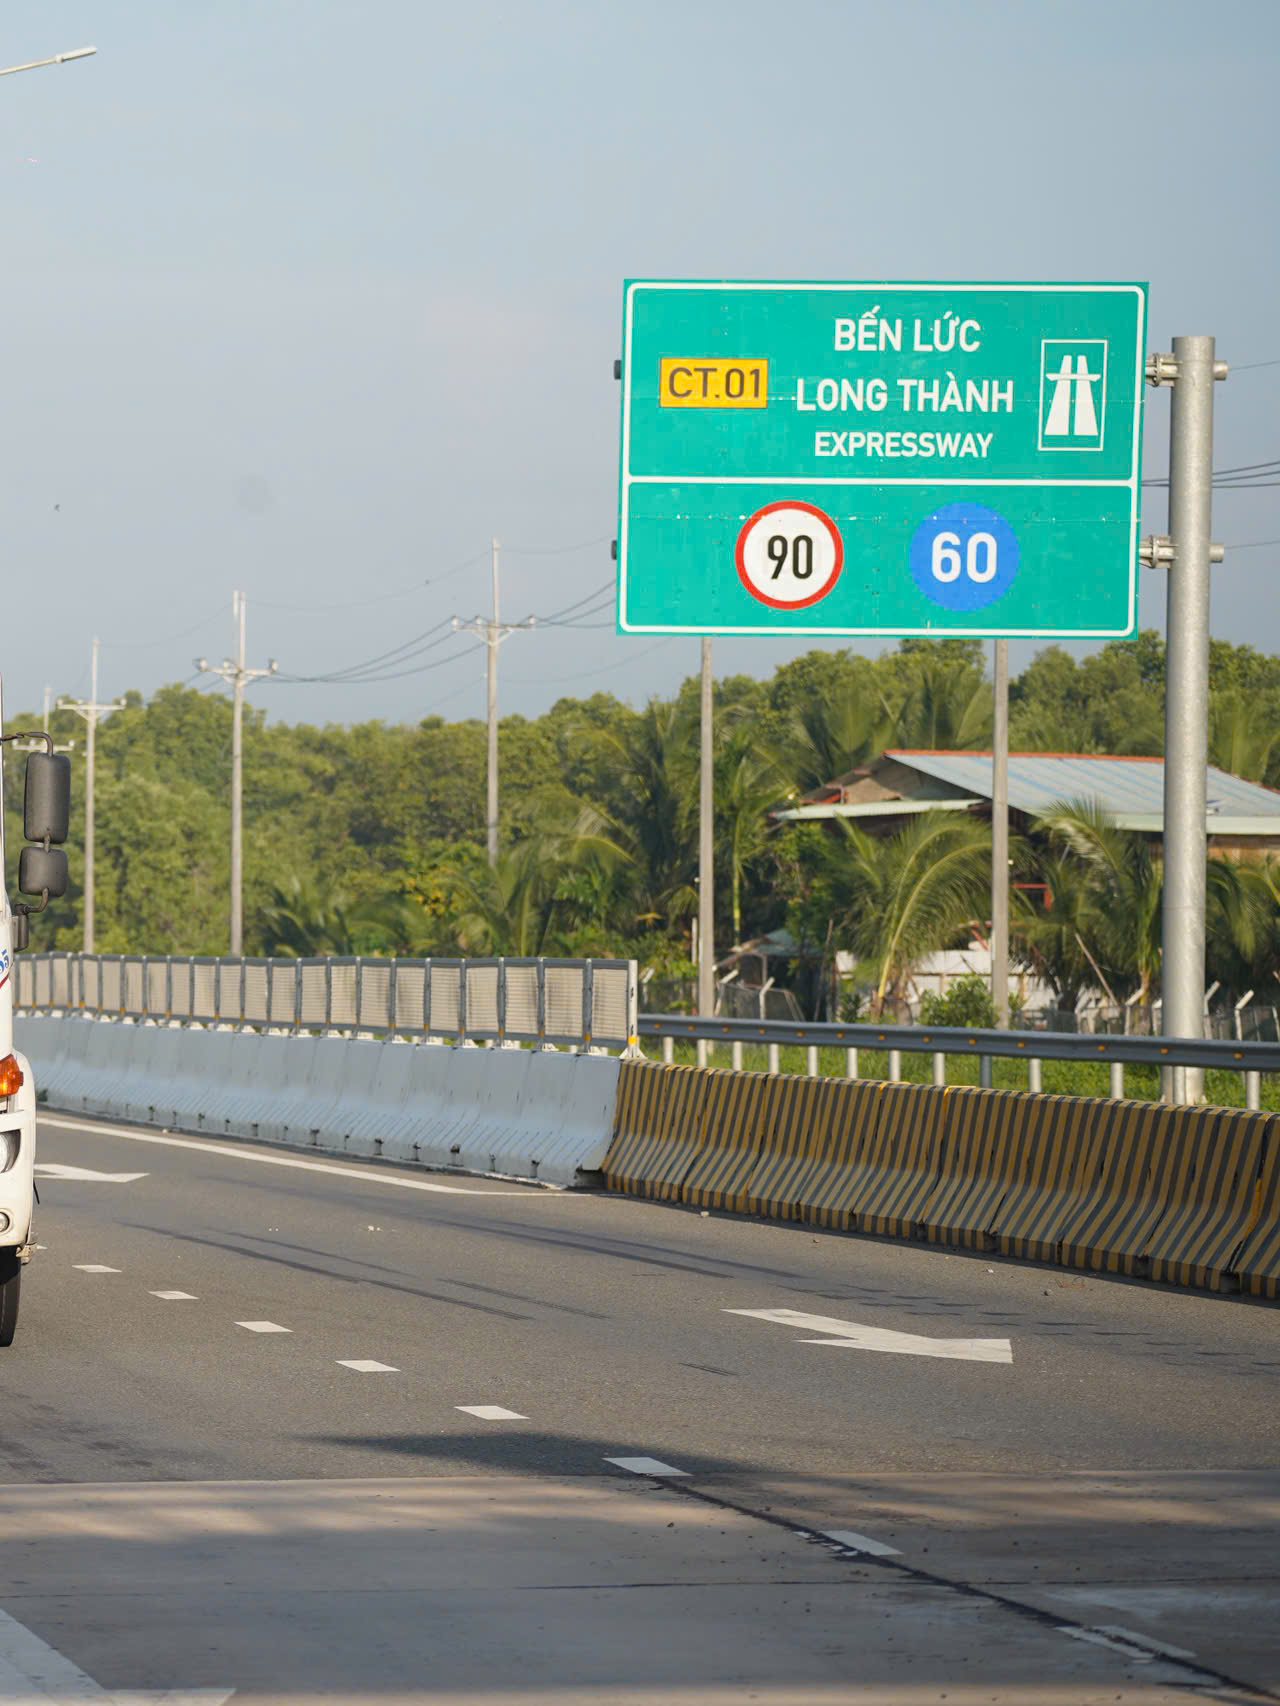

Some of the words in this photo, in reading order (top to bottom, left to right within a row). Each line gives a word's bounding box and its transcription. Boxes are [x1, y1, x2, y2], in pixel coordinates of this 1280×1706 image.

[834, 305, 902, 352] BẾN
[914, 311, 981, 353] LỨC
[668, 366, 762, 399] CT.01
[797, 378, 888, 412] LONG
[897, 371, 1013, 413] THÀNH
[815, 431, 993, 458] EXPRESSWAY
[767, 534, 814, 580] 90
[931, 532, 998, 583] 60
